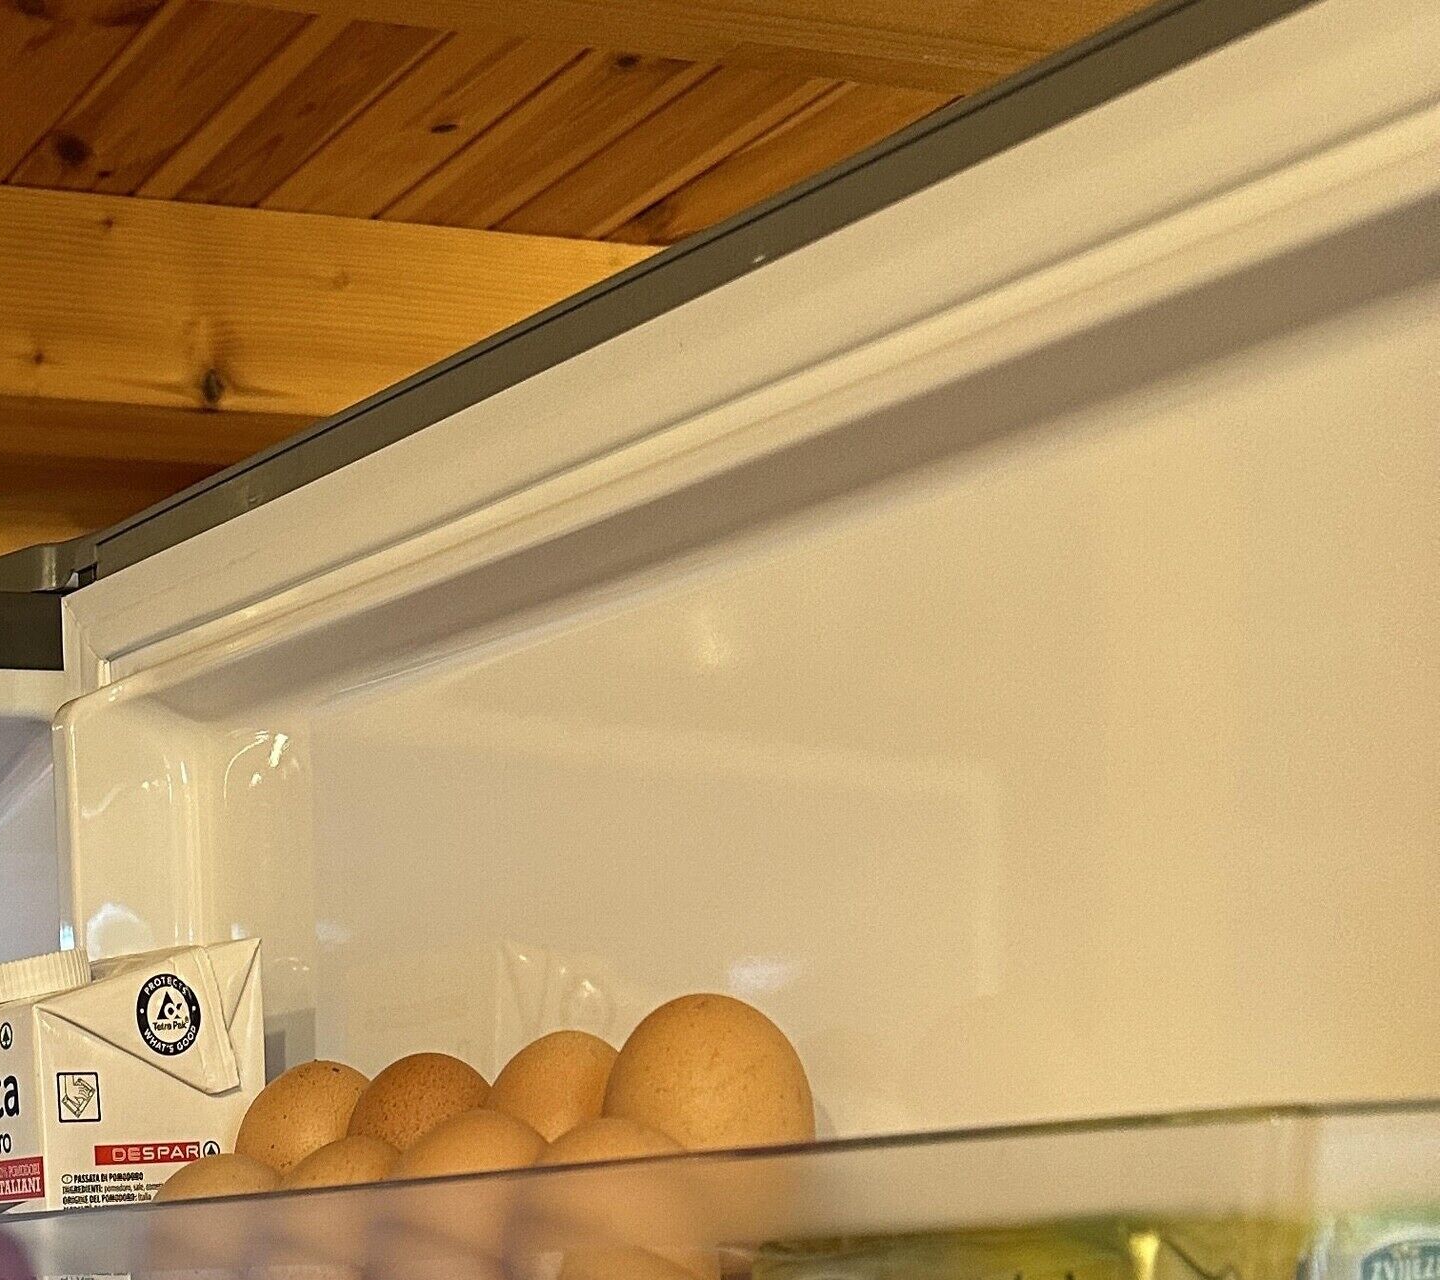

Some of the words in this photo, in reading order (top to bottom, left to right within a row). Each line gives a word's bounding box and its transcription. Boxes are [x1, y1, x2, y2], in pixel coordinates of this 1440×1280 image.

[144, 976, 188, 996] PROTECTS
[144, 1028, 174, 1053] WHAT'S
[176, 1024, 197, 1051] GOOD
[111, 1145, 200, 1163] DESPAR
[73, 1173, 100, 1184] PASSATA
